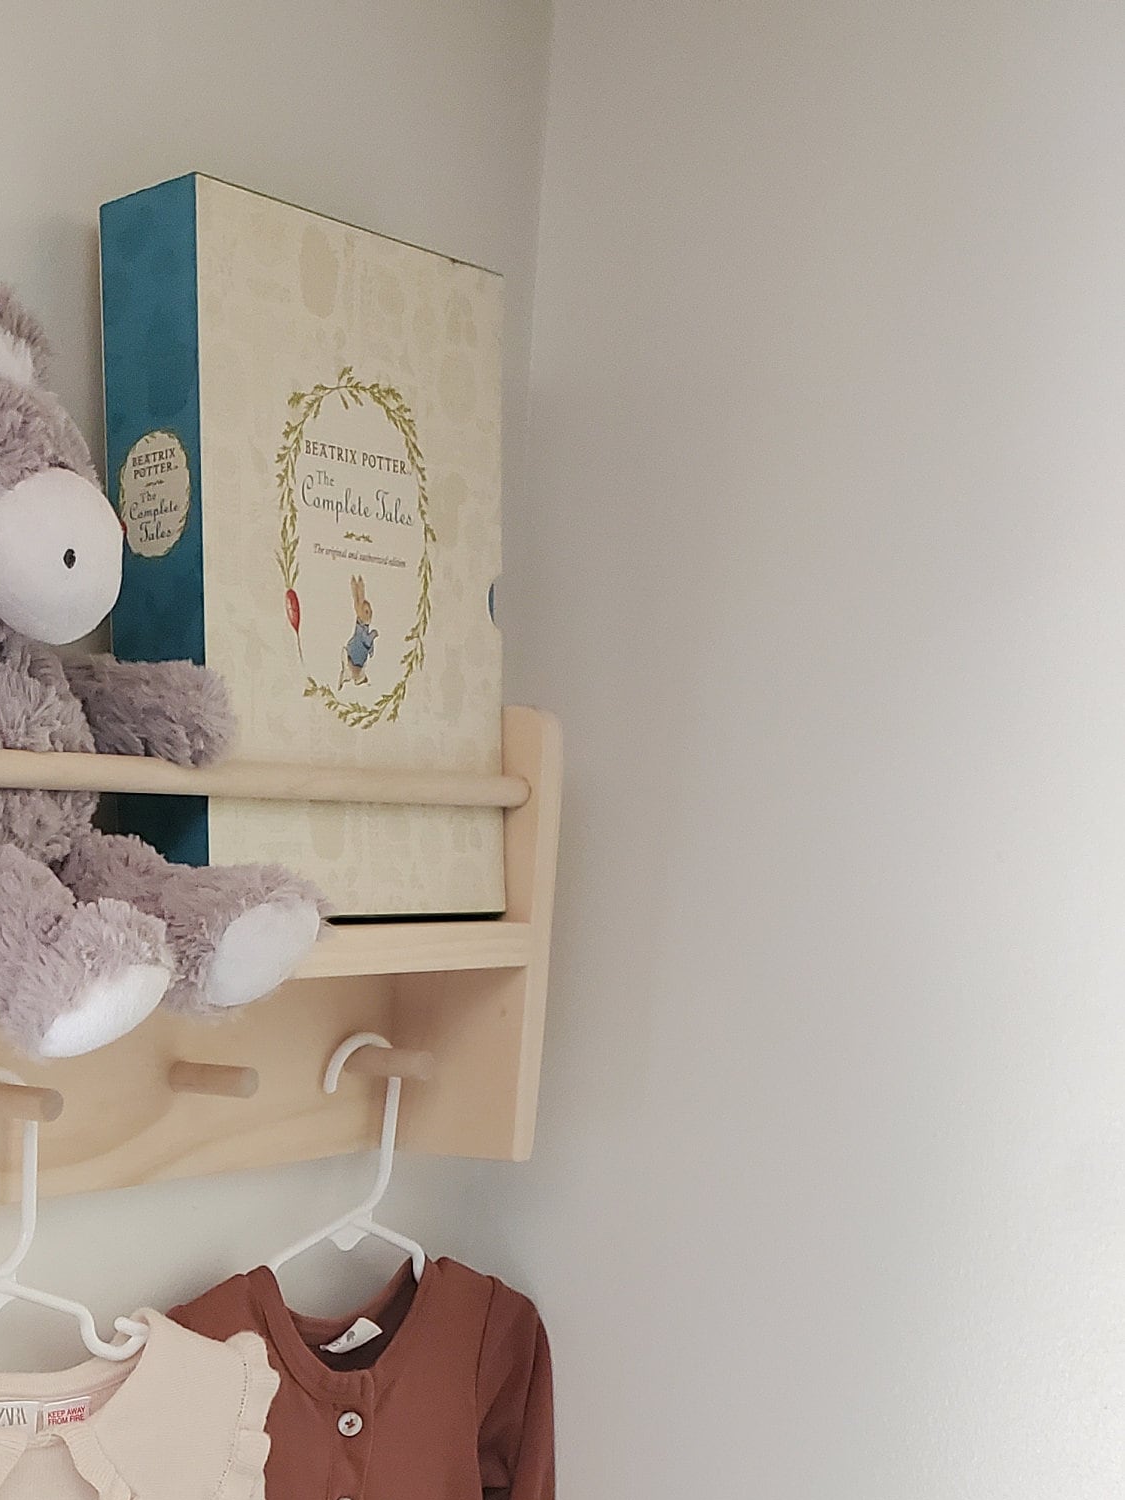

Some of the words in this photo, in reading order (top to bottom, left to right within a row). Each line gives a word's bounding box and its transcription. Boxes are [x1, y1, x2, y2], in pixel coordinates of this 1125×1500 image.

[132, 447, 176, 467] BEATRIX
[305, 439, 357, 465] BEATRIX
[316, 470, 335, 487] The
[140, 491, 157, 503] The
[301, 474, 372, 524] Complete
[375, 489, 414, 527] Tales
[129, 498, 179, 521] Complete
[139, 521, 172, 542] Tales
[47, 1409, 66, 1419] KEEP
[66, 1406, 86, 1416] AWAY
[47, 1416, 69, 1427] FROM
[69, 1413, 85, 1423] FIRE
